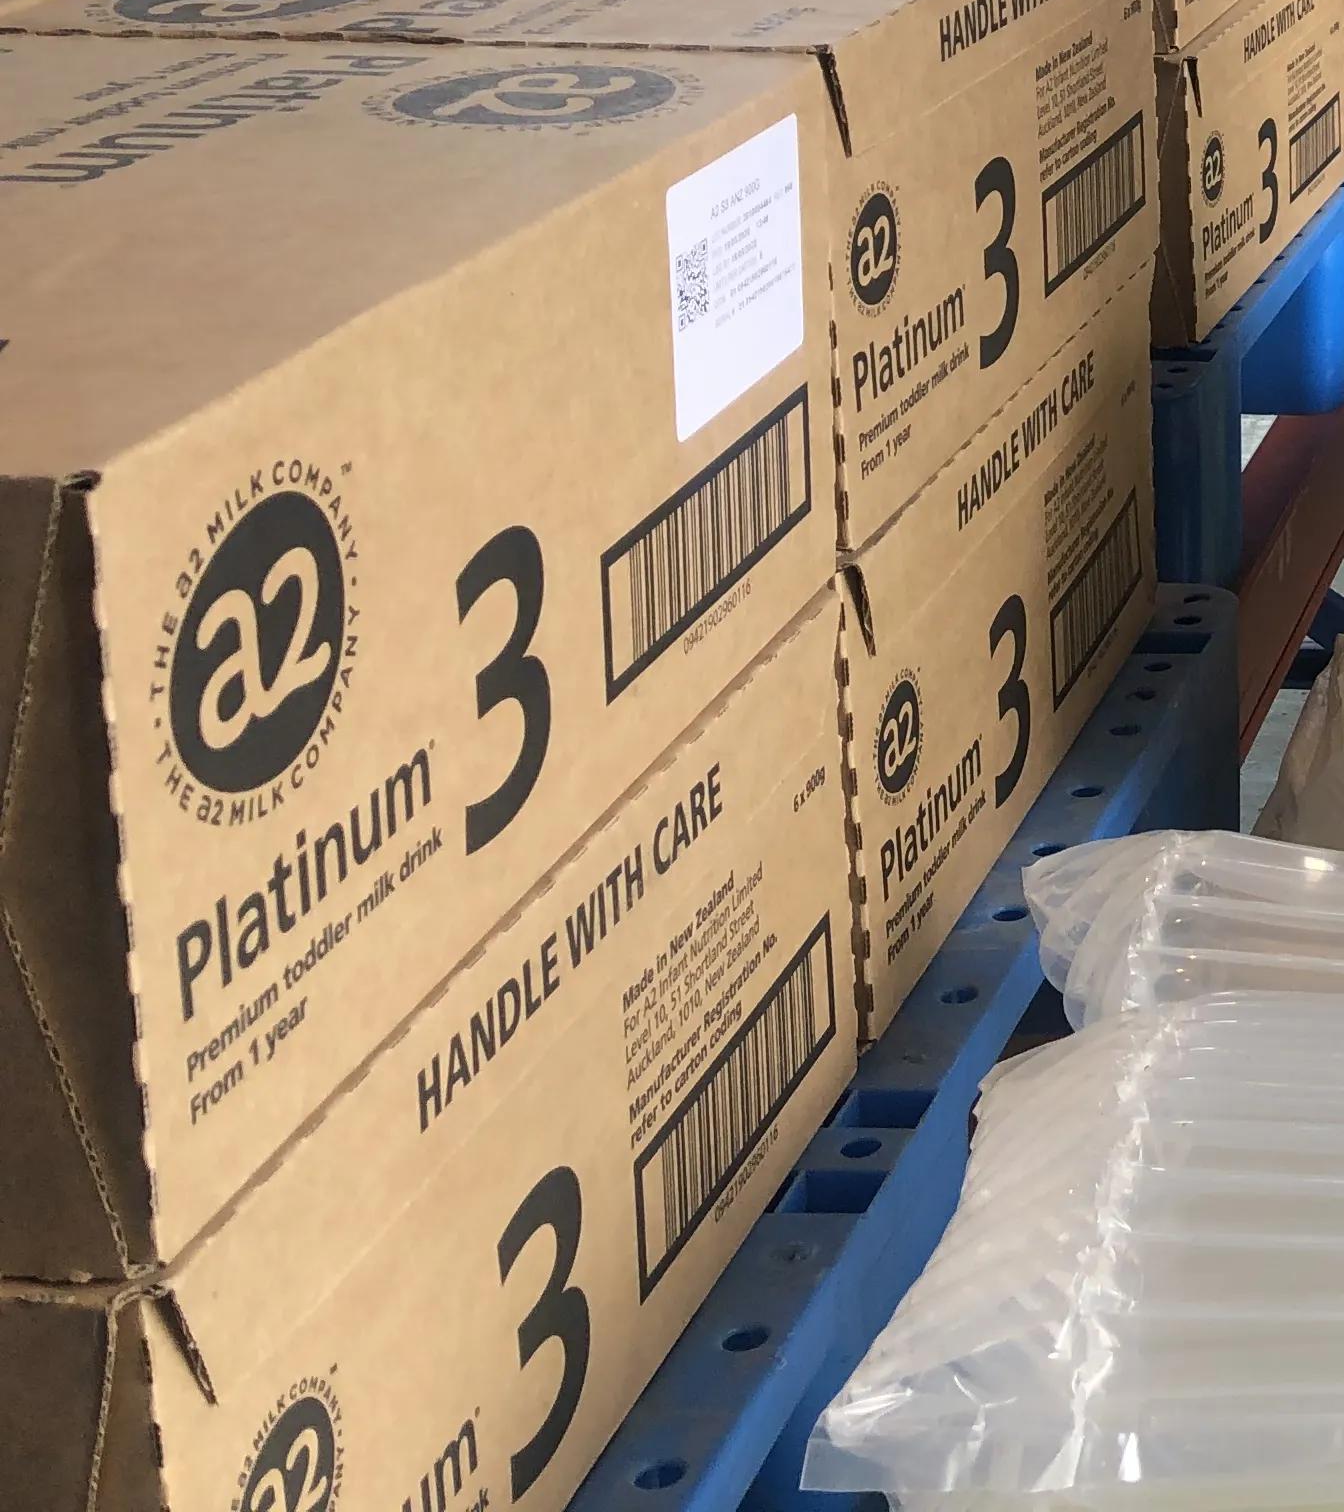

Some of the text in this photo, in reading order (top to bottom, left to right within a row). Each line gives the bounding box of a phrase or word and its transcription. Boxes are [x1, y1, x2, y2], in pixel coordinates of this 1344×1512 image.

[1243, 13, 1277, 64] HANDLE
[1276, 3, 1296, 38] WITH
[857, 214, 894, 287] a2
[1202, 192, 1255, 262] Platinum
[1203, 148, 1223, 191] a2
[1258, 117, 1278, 245] 3
[974, 156, 1019, 371] 3
[852, 285, 966, 414] Platinum
[858, 341, 970, 452] Premium toddler milk drink
[861, 423, 912, 481] From 1 year
[957, 428, 1020, 532] HANDLE
[1021, 389, 1058, 459] WITH
[1060, 350, 1095, 416] CARE
[150, 458, 360, 703] THE a2 MILK COMPANY
[196, 545, 333, 751] a2
[154, 604, 361, 828] THE a2 MILK COMPANY
[455, 524, 553, 856] 3
[883, 700, 917, 778] a2
[988, 593, 1031, 810] 3
[793, 794, 801, 814] 6
[805, 765, 827, 794] 900g
[880, 737, 982, 904] Platinum
[885, 788, 987, 939] Premium toddler milk drink
[176, 748, 433, 1023] Platinum
[186, 826, 444, 1084] Premium toddler milk drink
[416, 760, 723, 1136] HANDLE WITH CARE
[622, 869, 735, 1014] Made in New Zealand
[623, 859, 763, 1040] For A2 Infant Nutrition Limited
[886, 890, 935, 966] From 1 year
[190, 994, 309, 1127] From 1 year
[625, 898, 755, 1065] Level 10, 51 Shortland Street
[627, 913, 760, 1092] Auckland, 1010, New Zealand
[628, 932, 778, 1125] Manufacturer Registration No.
[630, 999, 743, 1151] refer to carton coding
[496, 1165, 592, 1506] 3
